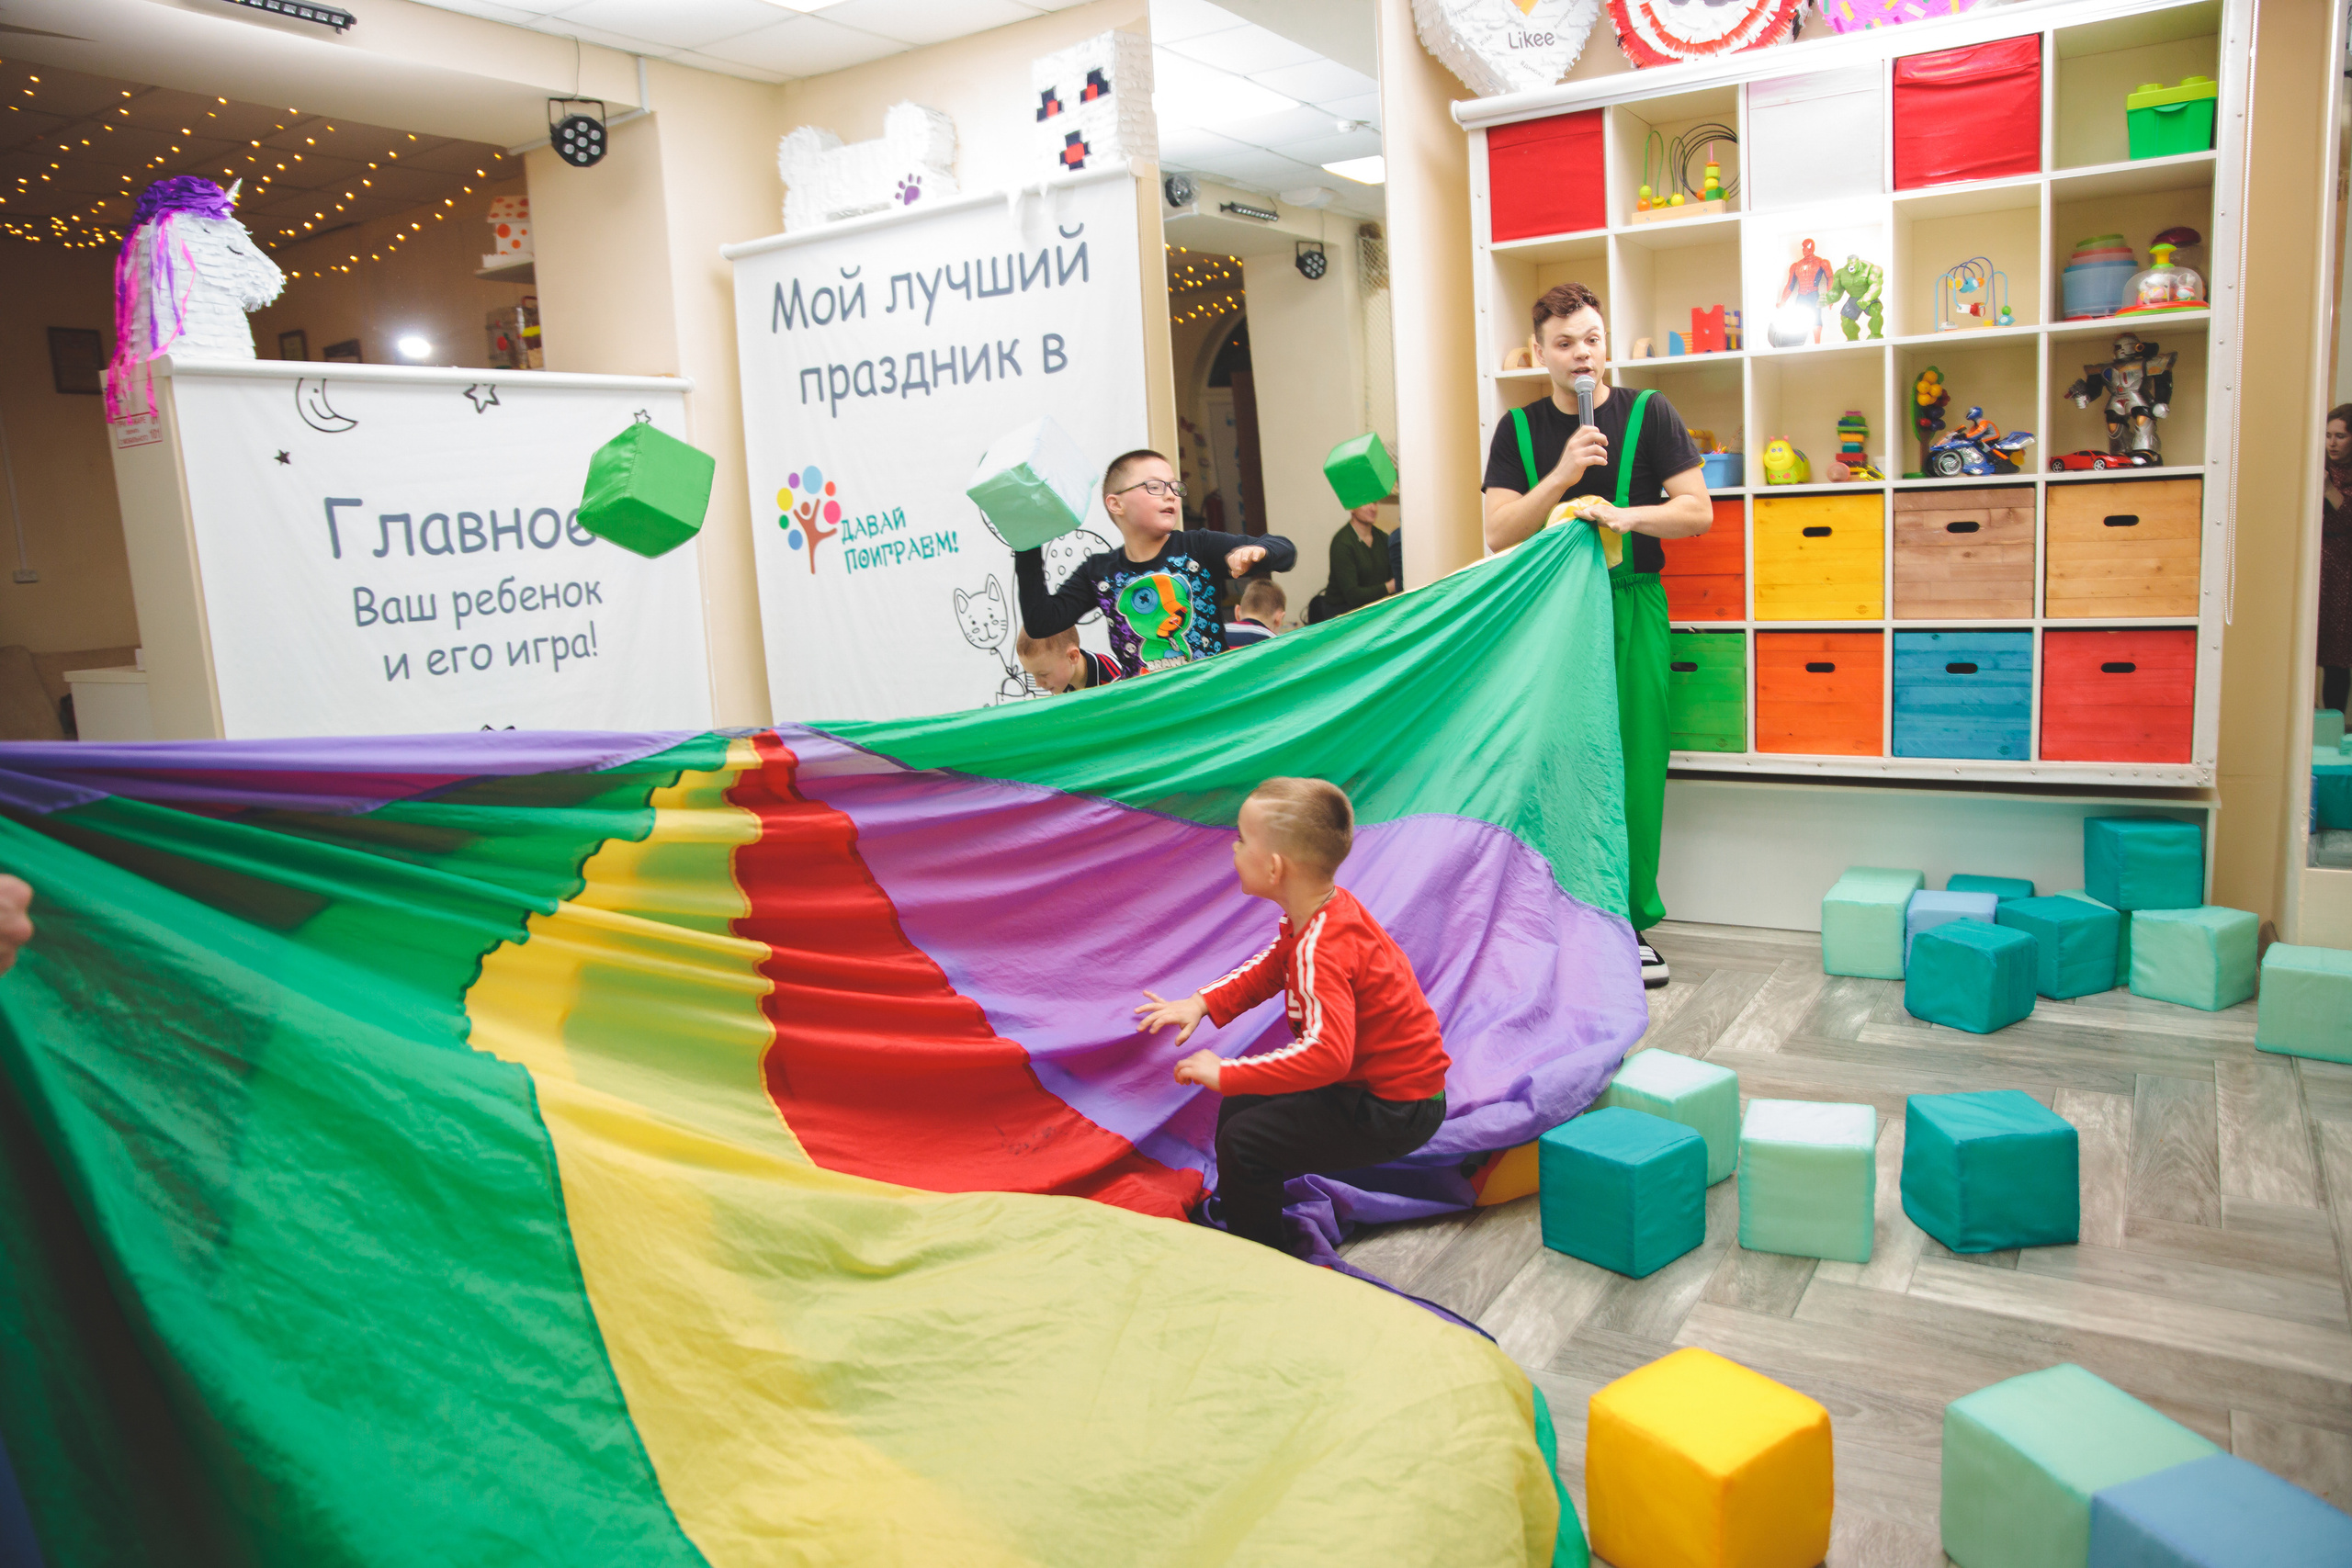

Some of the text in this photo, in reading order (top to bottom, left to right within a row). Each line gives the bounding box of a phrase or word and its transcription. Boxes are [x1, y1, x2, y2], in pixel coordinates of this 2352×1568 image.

[1508, 30, 1555, 50] Likee
[772, 223, 1089, 334] Мой лучший
[799, 333, 1068, 419] праздник в
[323, 497, 597, 559] Главное
[841, 506, 907, 545] ДАВАЙ
[843, 530, 959, 575] ПОИГРАЕМ!
[353, 575, 604, 632] Ваш ребенок
[383, 620, 597, 682] и его игра!
[1147, 655, 1188, 672] BRAWL
